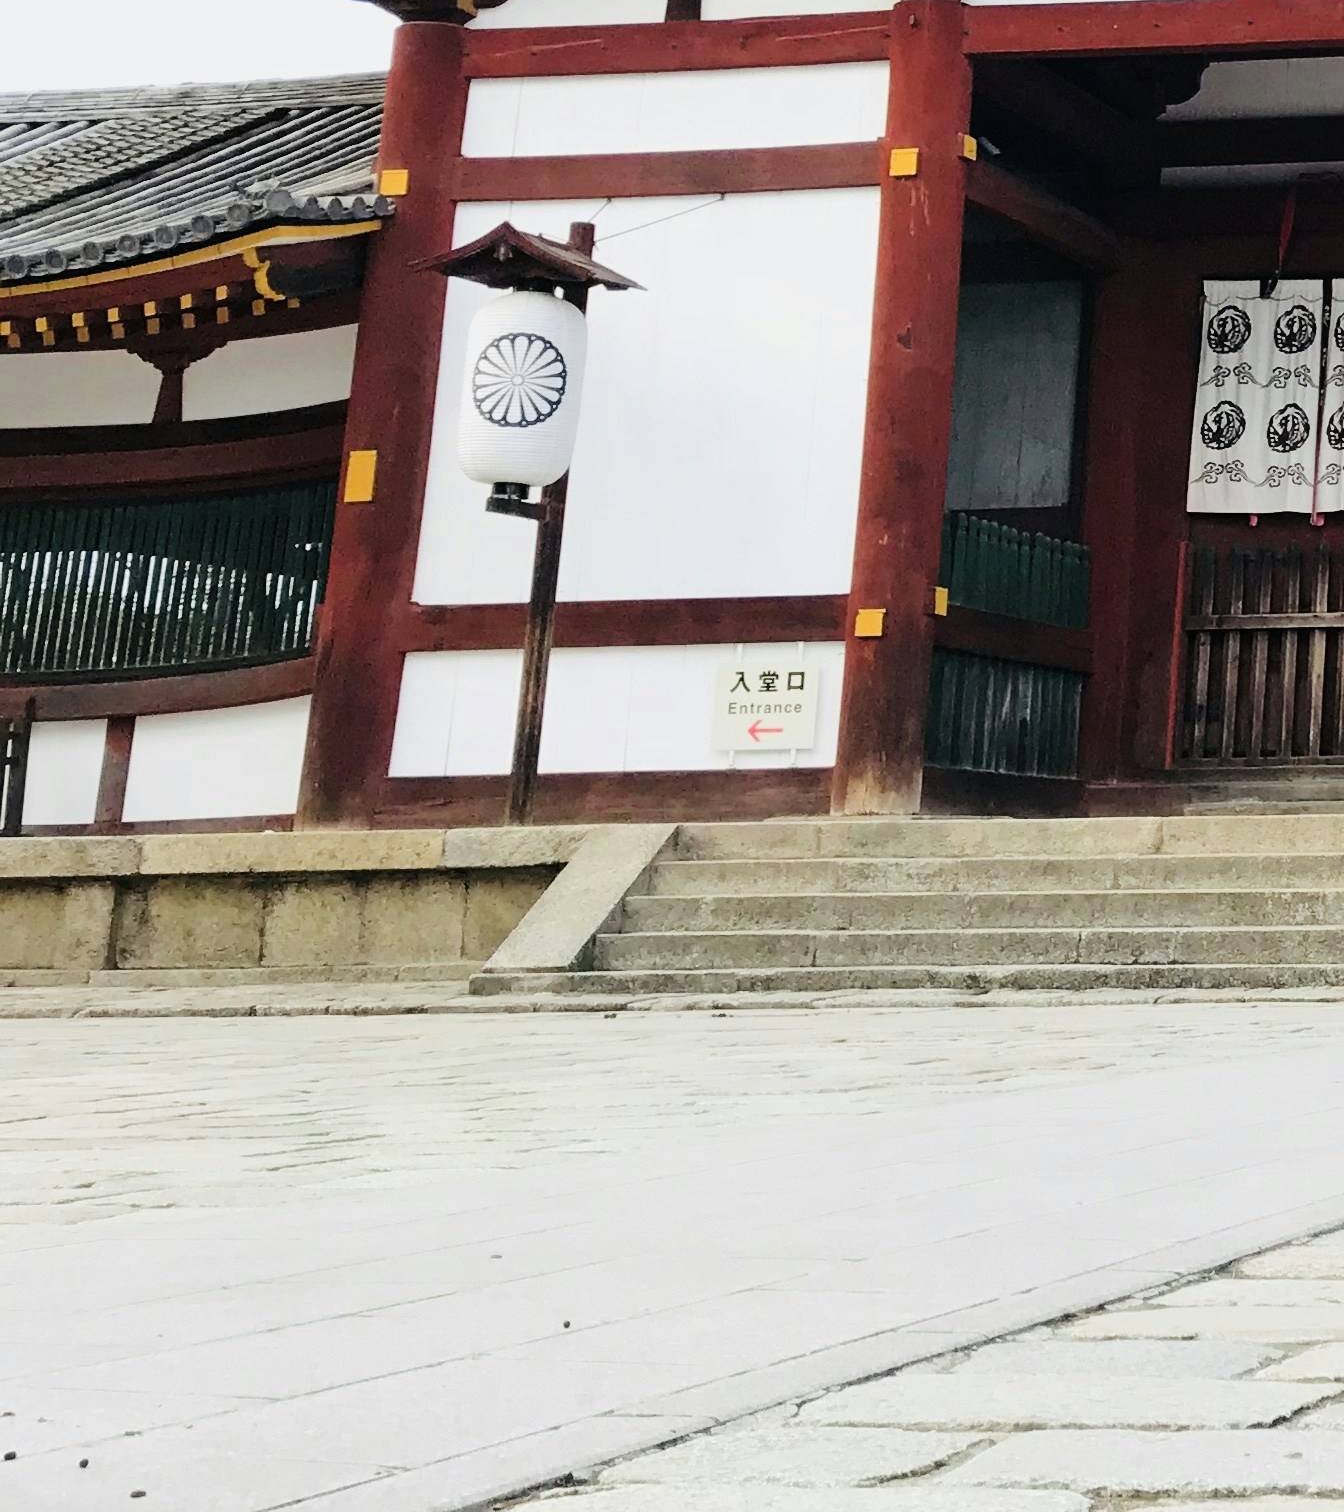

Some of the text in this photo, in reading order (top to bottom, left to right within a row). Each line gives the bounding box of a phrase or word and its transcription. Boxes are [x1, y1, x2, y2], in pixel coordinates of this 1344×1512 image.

[730, 670, 805, 693] 入堂口
[728, 702, 802, 714] Entrance
